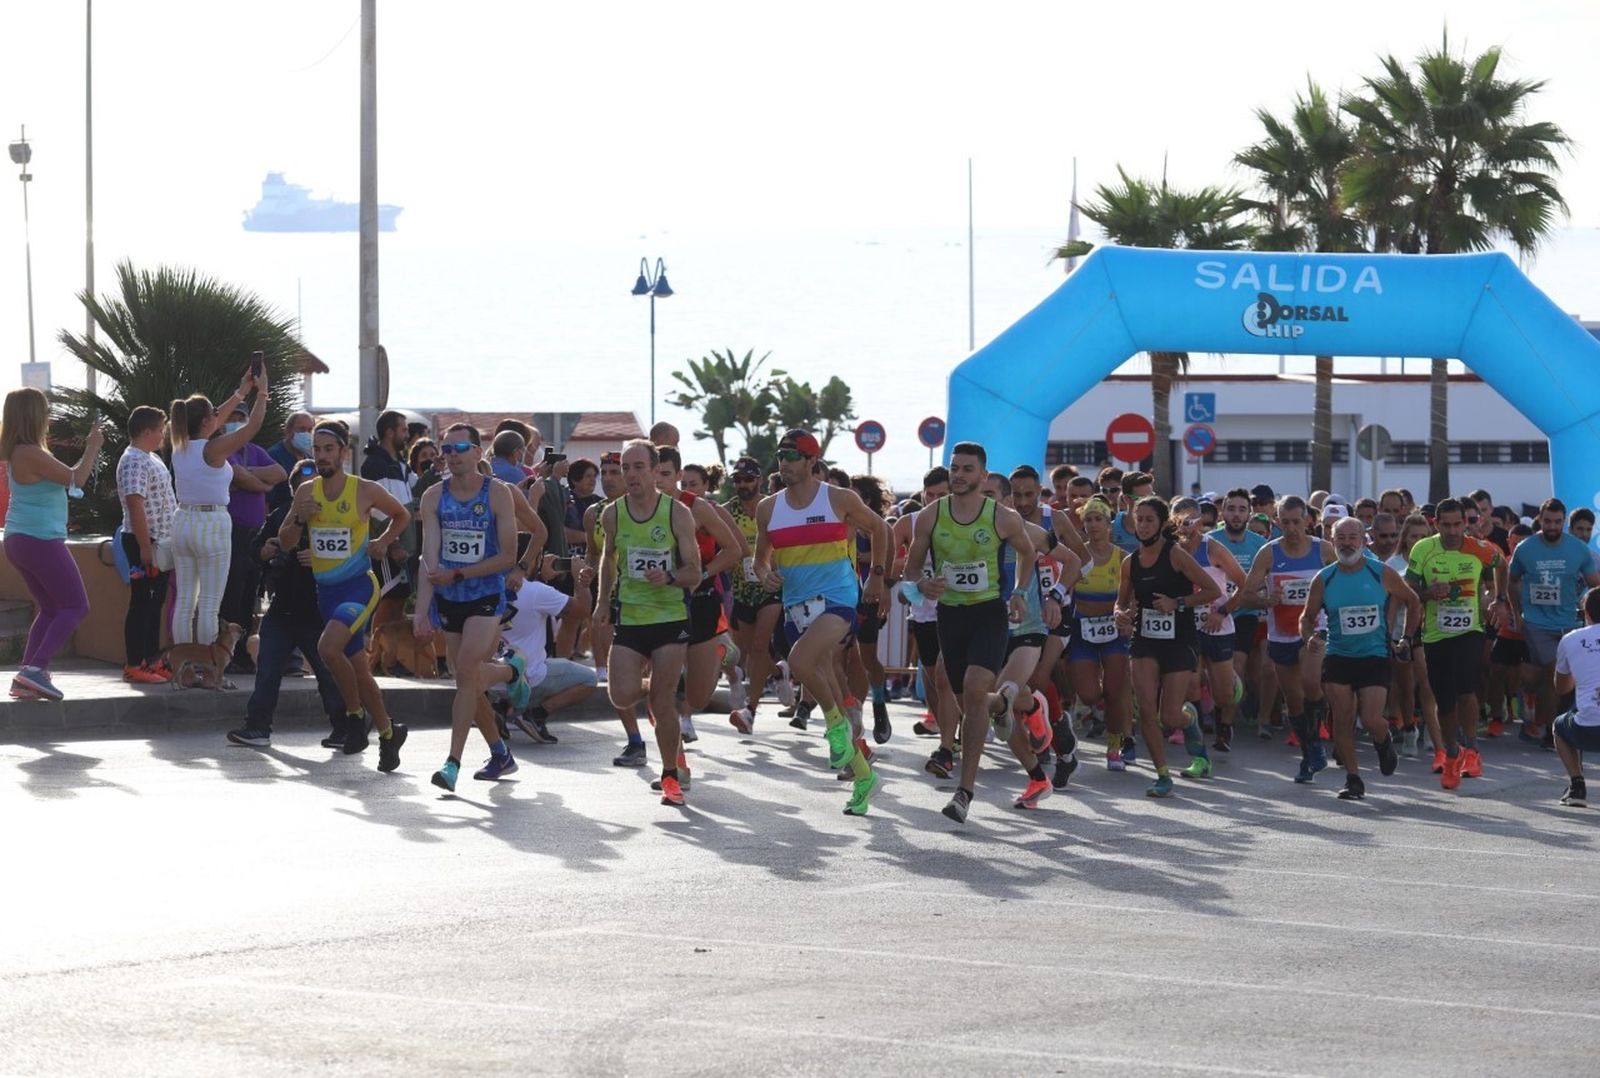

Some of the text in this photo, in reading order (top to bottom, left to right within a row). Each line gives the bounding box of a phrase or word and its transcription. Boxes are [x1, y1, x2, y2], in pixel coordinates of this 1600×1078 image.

[1195, 261, 1382, 294] SALIDA
[1257, 292, 1348, 329] DORSAL
[861, 432, 880, 442] BUS
[316, 539, 348, 552] 362
[449, 541, 479, 555] 391
[635, 559, 667, 571] 261
[956, 573, 979, 585] 20
[1287, 588, 1310, 600] 25
[1535, 591, 1557, 600] 221
[1145, 620, 1171, 632] 130
[1347, 615, 1377, 628] 337
[1443, 616, 1471, 628] 229
[1088, 625, 1115, 637] 149
